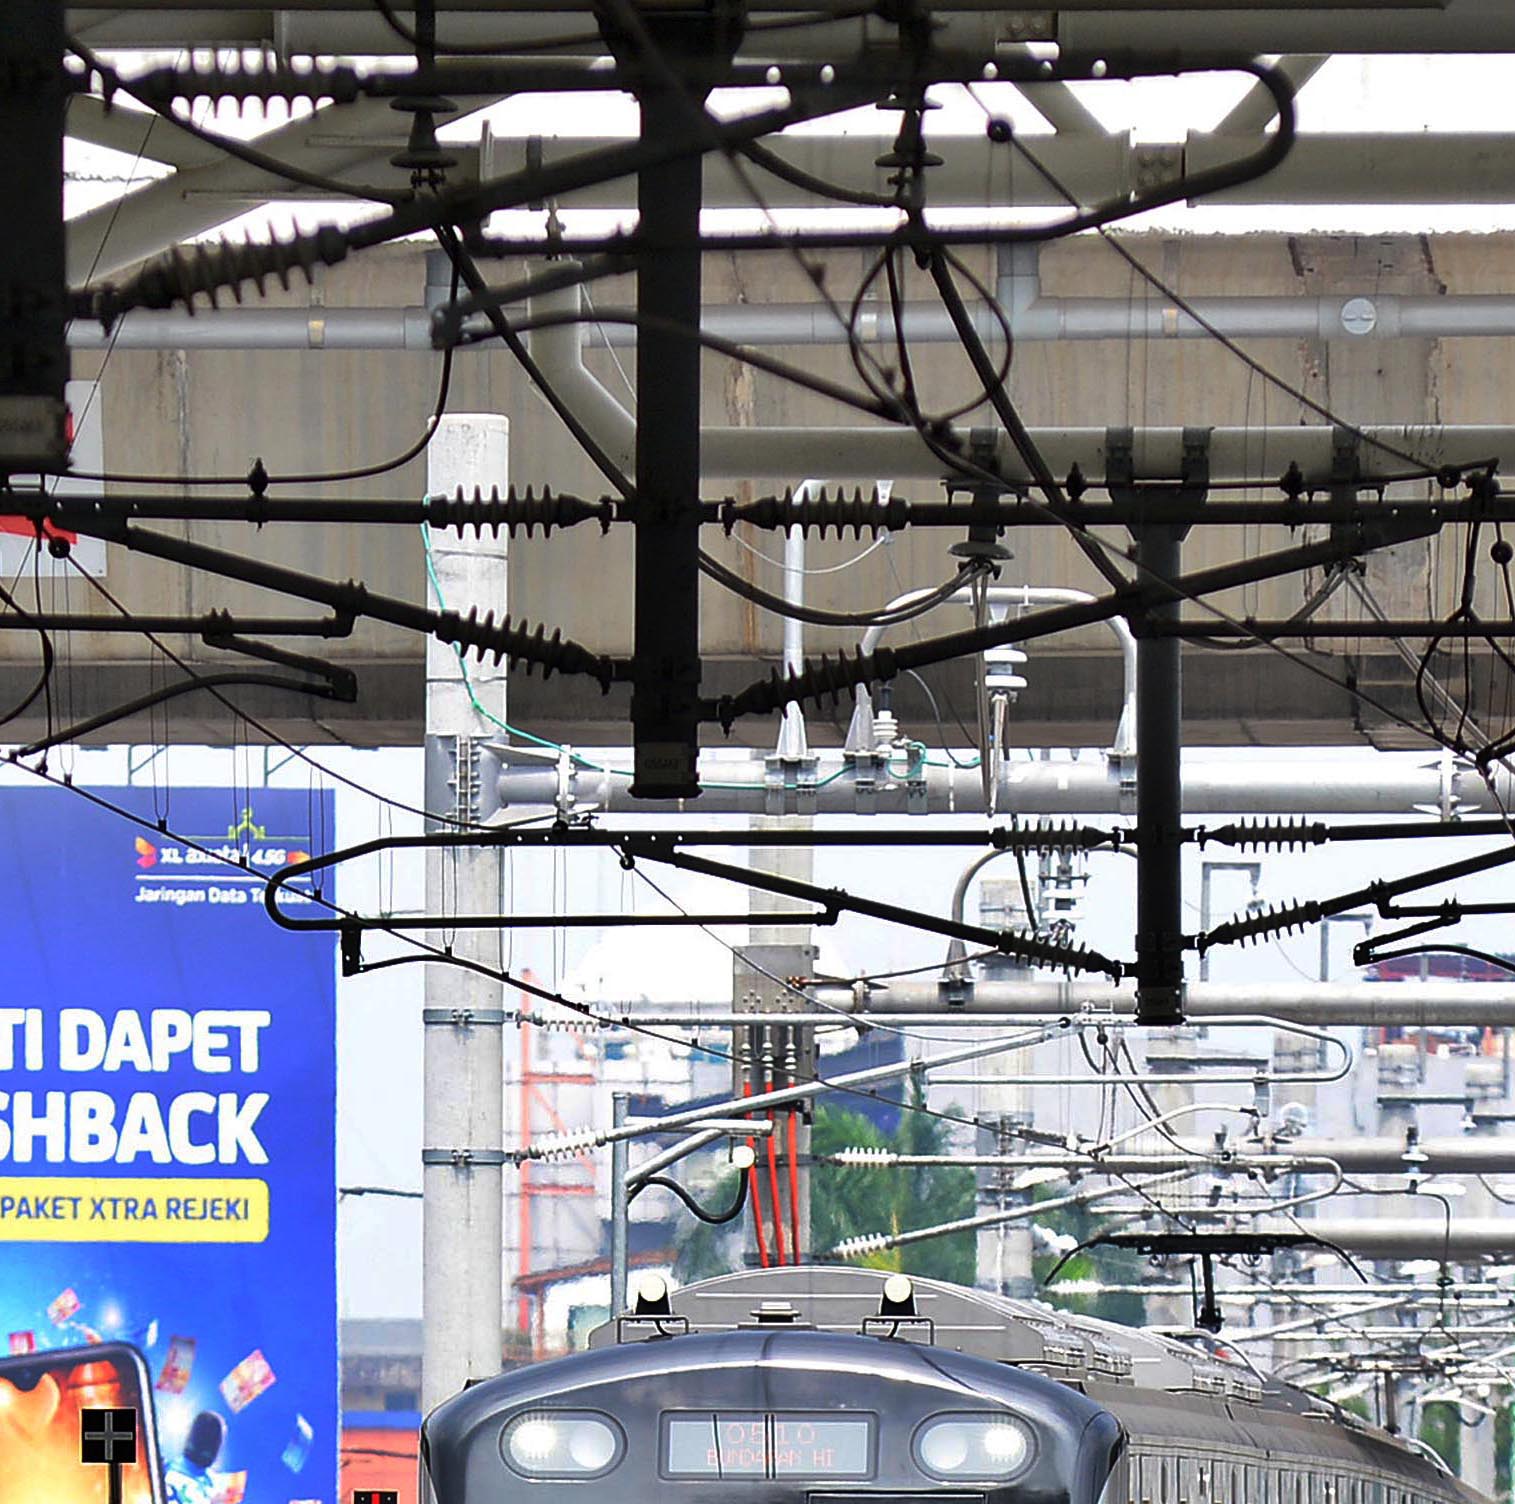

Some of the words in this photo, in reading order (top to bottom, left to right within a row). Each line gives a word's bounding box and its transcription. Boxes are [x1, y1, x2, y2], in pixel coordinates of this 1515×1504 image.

[160, 847, 183, 864] XL
[135, 886, 206, 906] Jaringan
[208, 886, 247, 904] Data
[250, 887, 313, 904] Tekuat
[59, 1008, 271, 1073] DAPET
[0, 1091, 270, 1165] HBACK
[0, 1196, 82, 1221] PAKET
[90, 1196, 158, 1221] XTRA
[166, 1197, 249, 1221] REJEKI
[707, 1448, 800, 1468] BUNDAAN
[812, 1448, 836, 1468] HI
